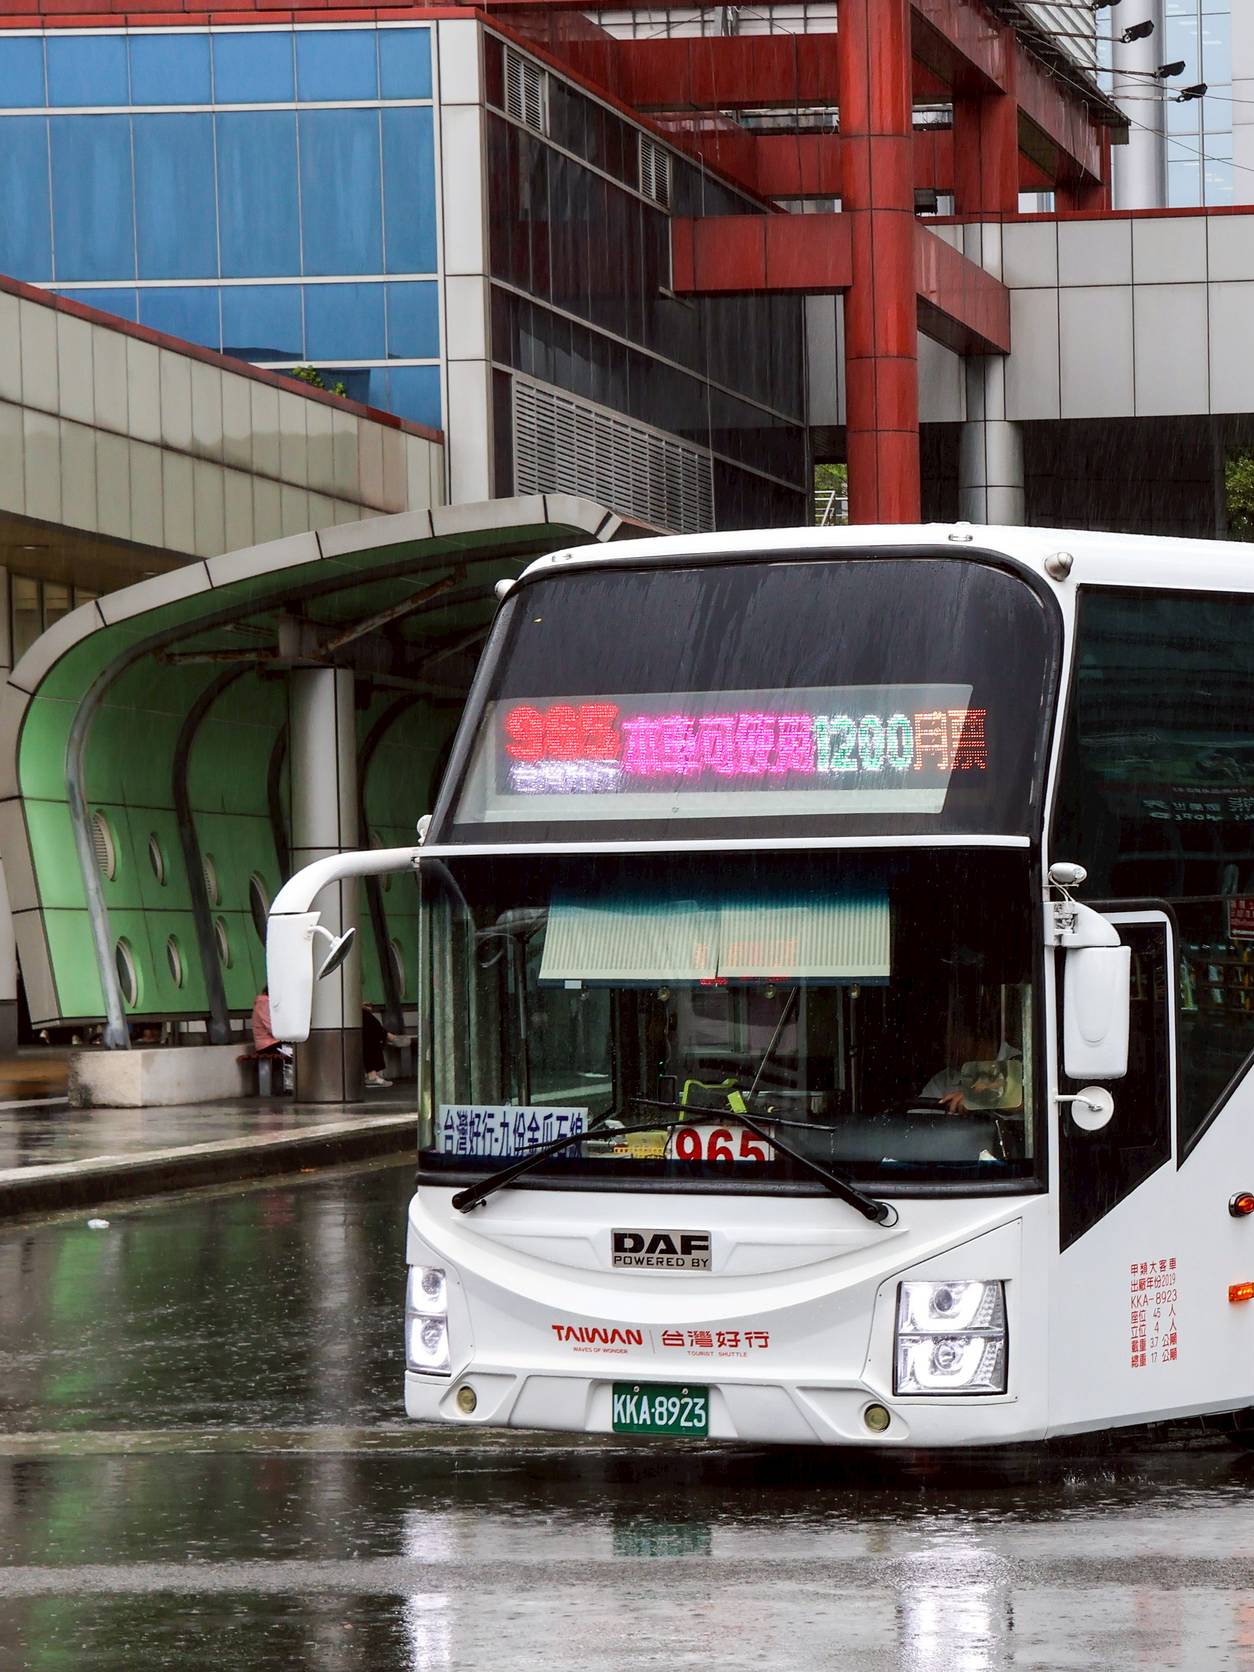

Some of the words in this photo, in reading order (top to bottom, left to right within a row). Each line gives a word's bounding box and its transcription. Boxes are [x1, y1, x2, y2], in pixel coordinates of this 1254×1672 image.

[506, 703, 619, 761] 965
[675, 1127, 767, 1161] 965
[613, 1232, 710, 1256] DAF
[613, 1256, 685, 1267] POWERED
[691, 1257, 709, 1268] BY
[1131, 1288, 1178, 1309] KKA-8923
[551, 1325, 643, 1345] TAIWAN
[662, 1330, 770, 1348] 台灣好行
